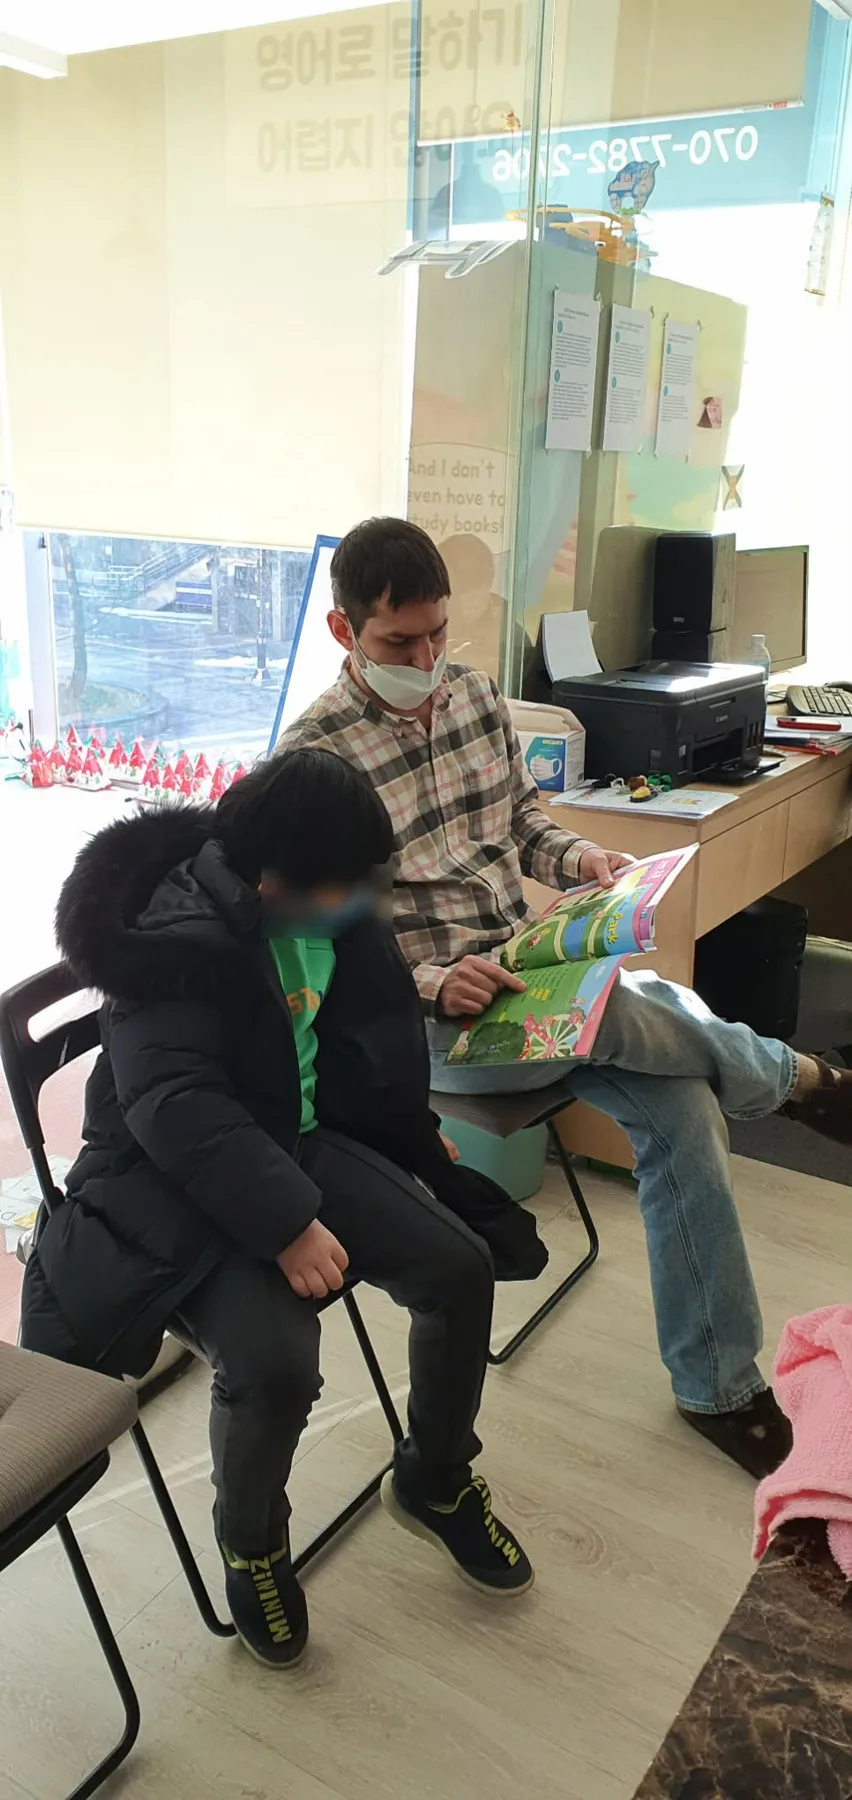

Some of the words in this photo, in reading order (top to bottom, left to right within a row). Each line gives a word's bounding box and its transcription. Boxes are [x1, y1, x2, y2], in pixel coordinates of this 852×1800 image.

[256, 24, 376, 92] 영어로
[257, 113, 373, 175] 어렵지
[451, 459, 496, 479] don't
[446, 487, 484, 506] have
[488, 489, 505, 507] to
